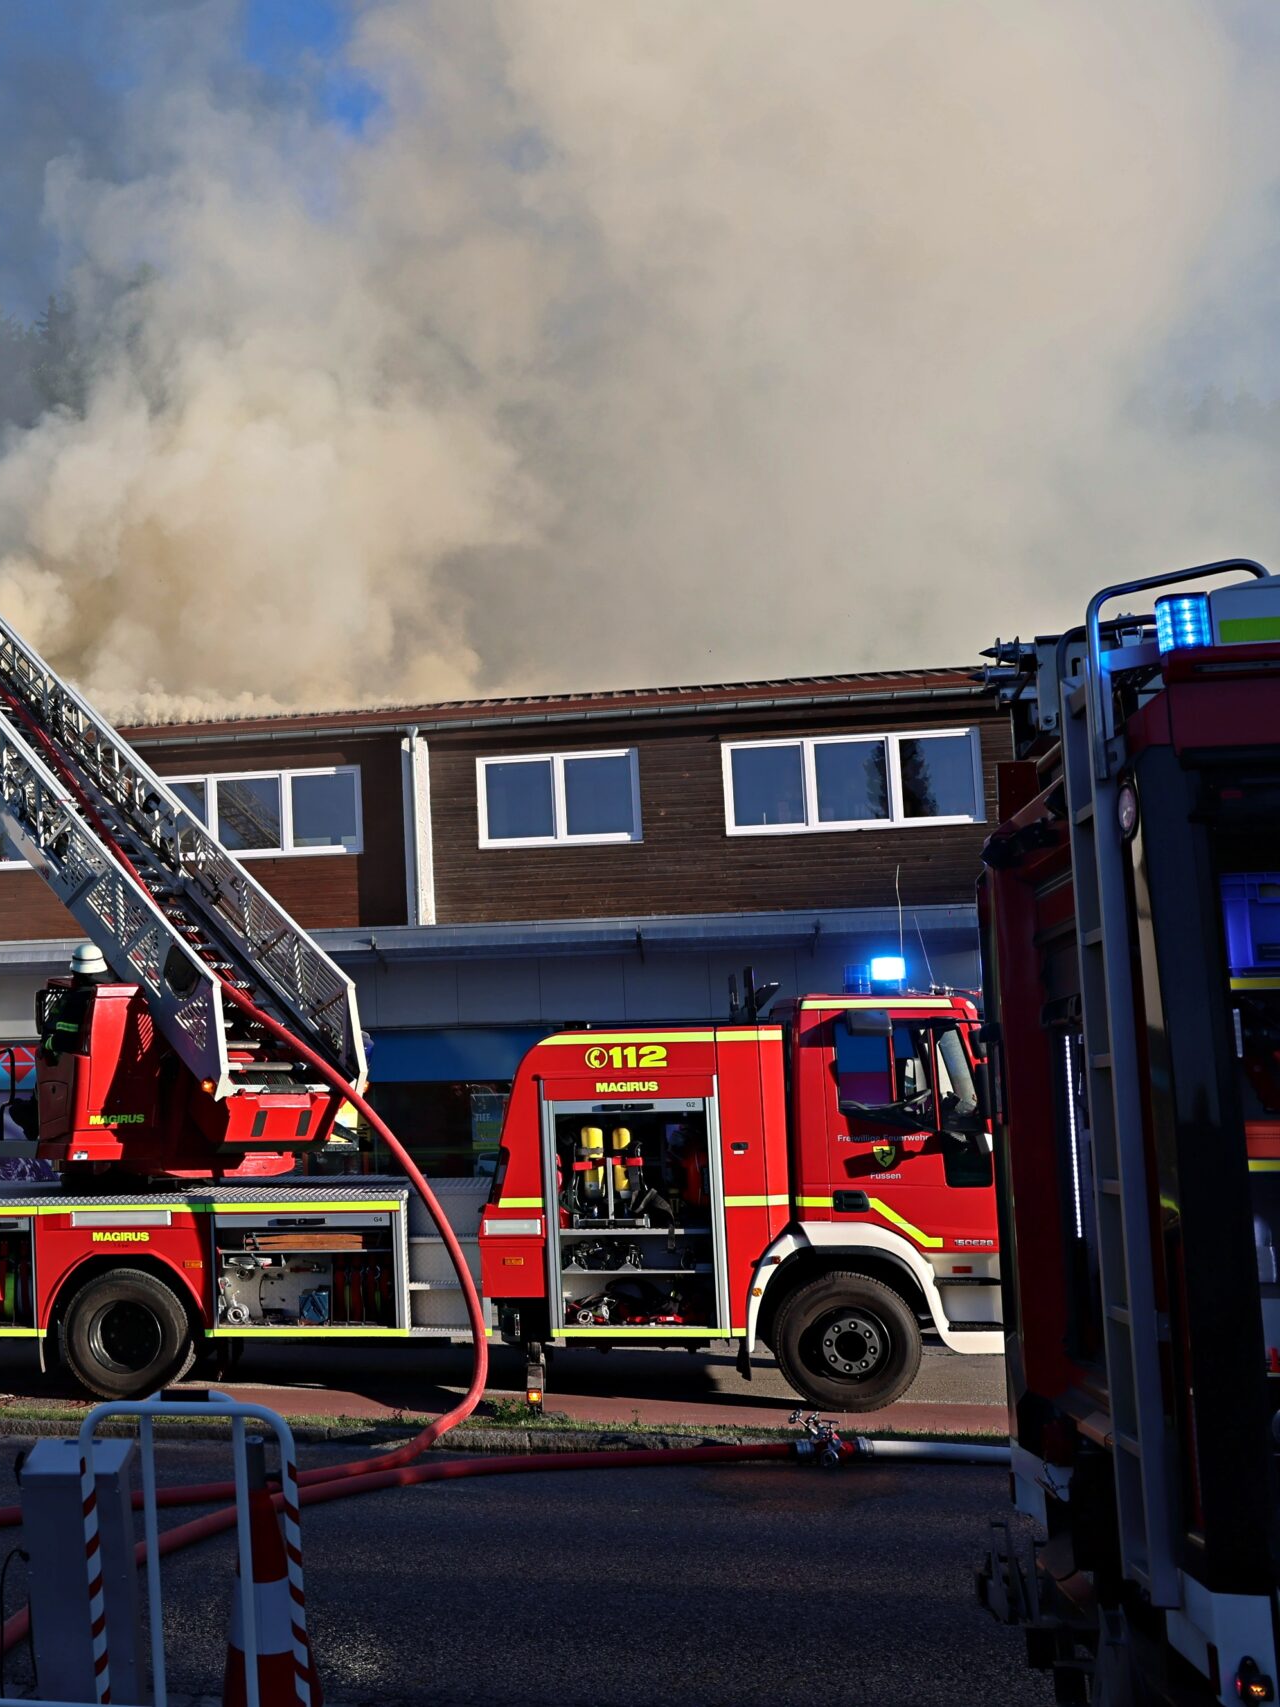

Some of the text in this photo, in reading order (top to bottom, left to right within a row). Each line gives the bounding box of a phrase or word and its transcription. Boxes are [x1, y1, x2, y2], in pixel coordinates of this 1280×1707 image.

[609, 1045, 668, 1068] 112
[595, 1081, 659, 1093] MAGIRUS
[89, 1114, 145, 1124] MAGIRUS
[837, 1133, 929, 1142] Freiwillige Feuerwehr
[92, 1232, 150, 1242] MAGIRUS
